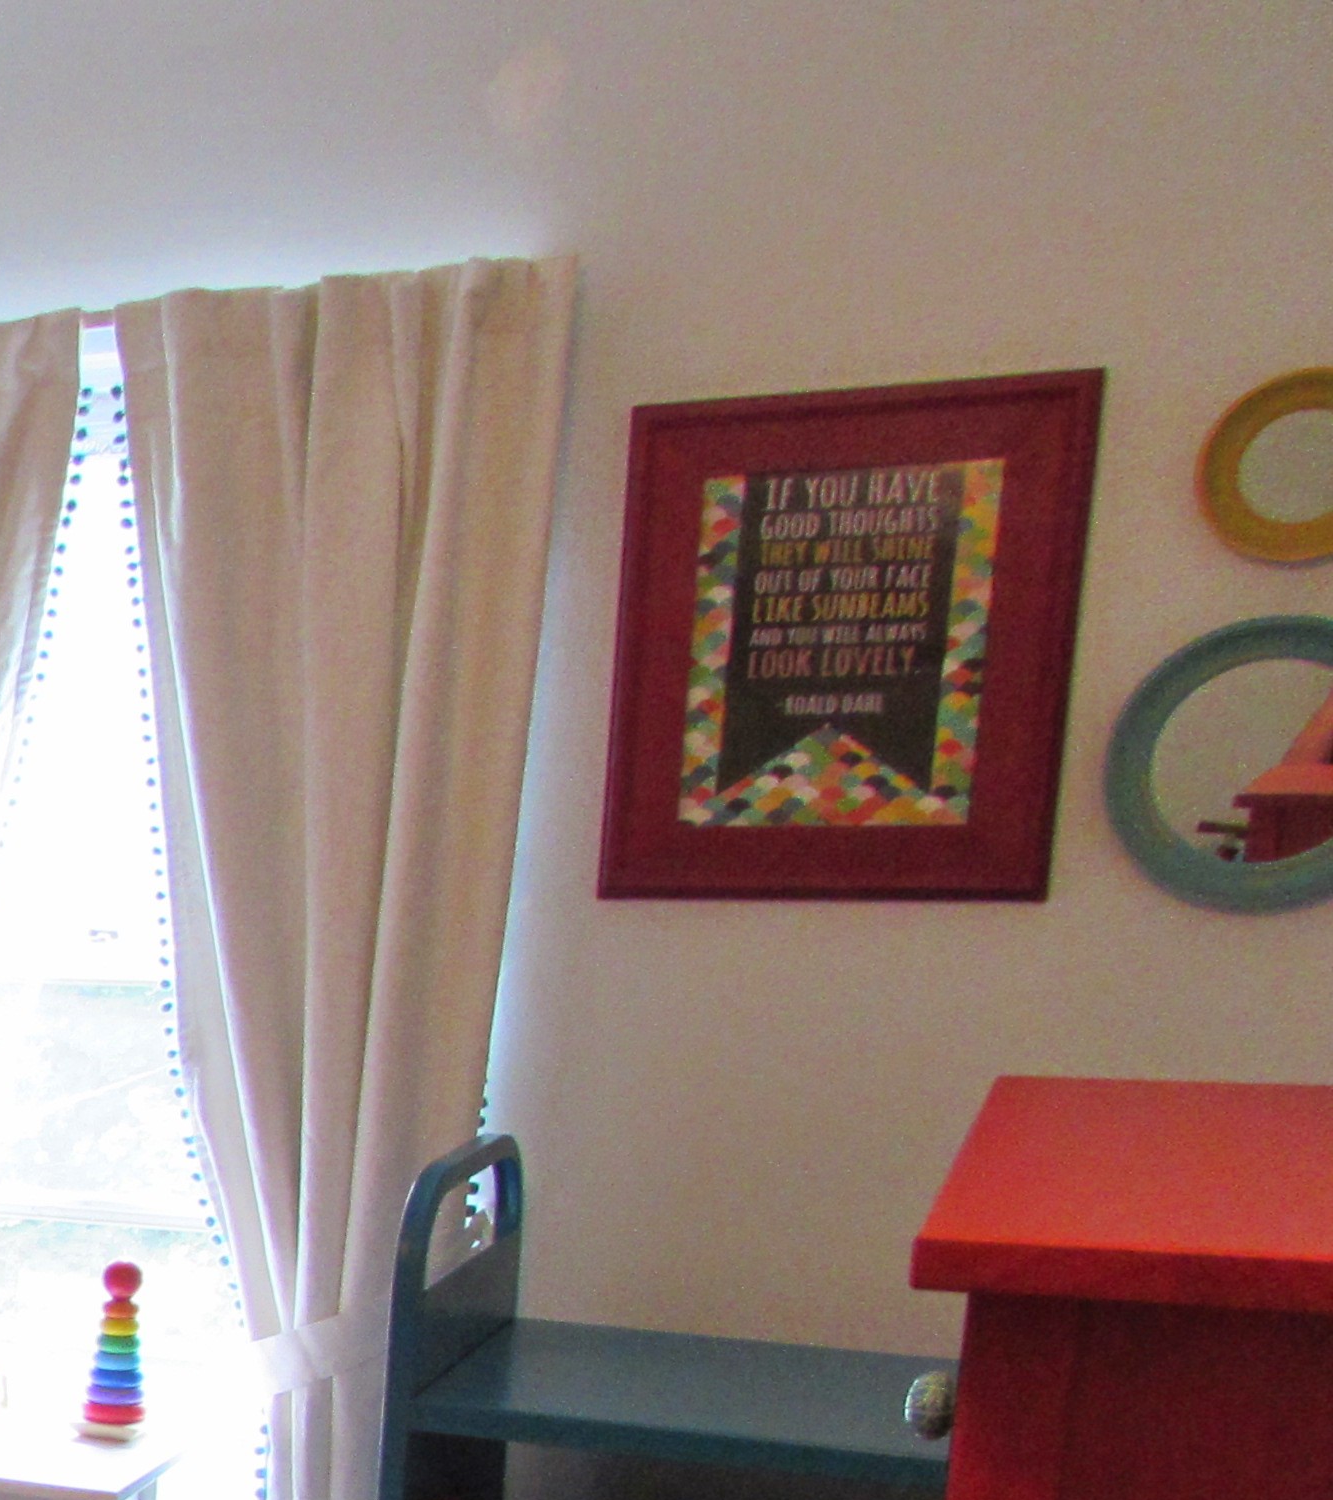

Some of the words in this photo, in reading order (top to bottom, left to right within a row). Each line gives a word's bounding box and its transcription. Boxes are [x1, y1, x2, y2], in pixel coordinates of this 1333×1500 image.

[766, 477, 794, 511] IF
[805, 473, 860, 509] YOU
[868, 470, 940, 505] HAVE
[760, 511, 822, 541] GOOD
[828, 505, 941, 537] THOUGHTS
[754, 568, 794, 594] OUT
[798, 567, 824, 593] OF
[830, 564, 882, 590] YOUR
[885, 562, 934, 589] FACE
[752, 594, 807, 624] LIKE
[812, 590, 931, 621] SUNBEAMS
[865, 620, 929, 643] ALWAYS
[747, 649, 813, 680] LOOK
